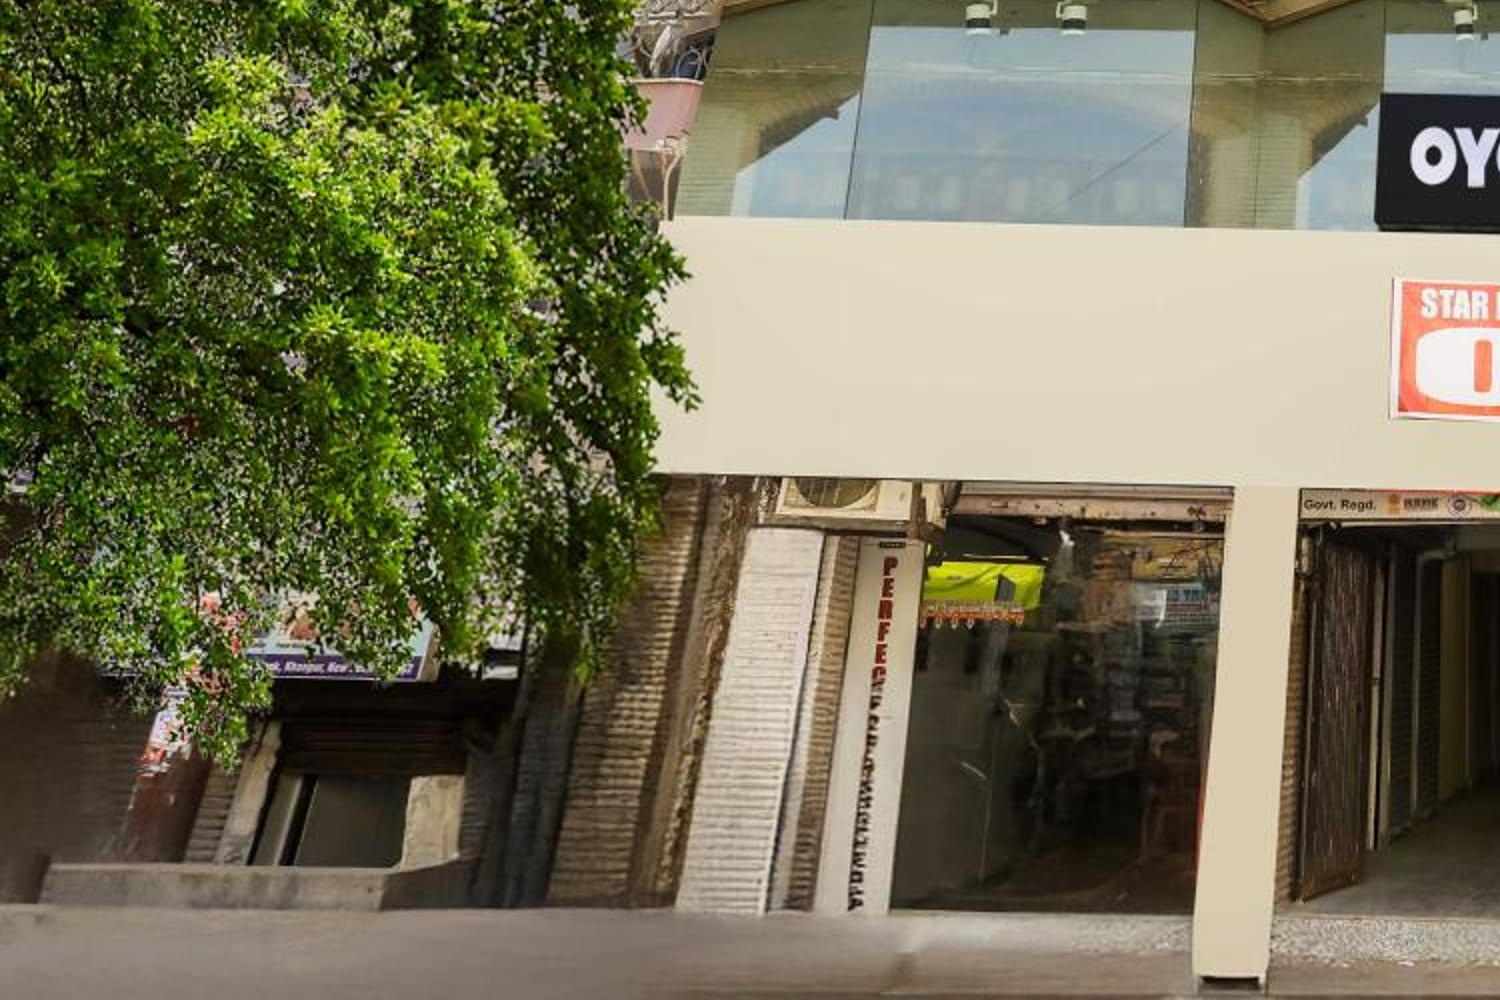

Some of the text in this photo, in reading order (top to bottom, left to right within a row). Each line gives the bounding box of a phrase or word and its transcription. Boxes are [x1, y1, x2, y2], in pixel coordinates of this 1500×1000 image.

[1421, 289, 1490, 319] STAR
[1304, 499, 1377, 512] Govt. Regd.
